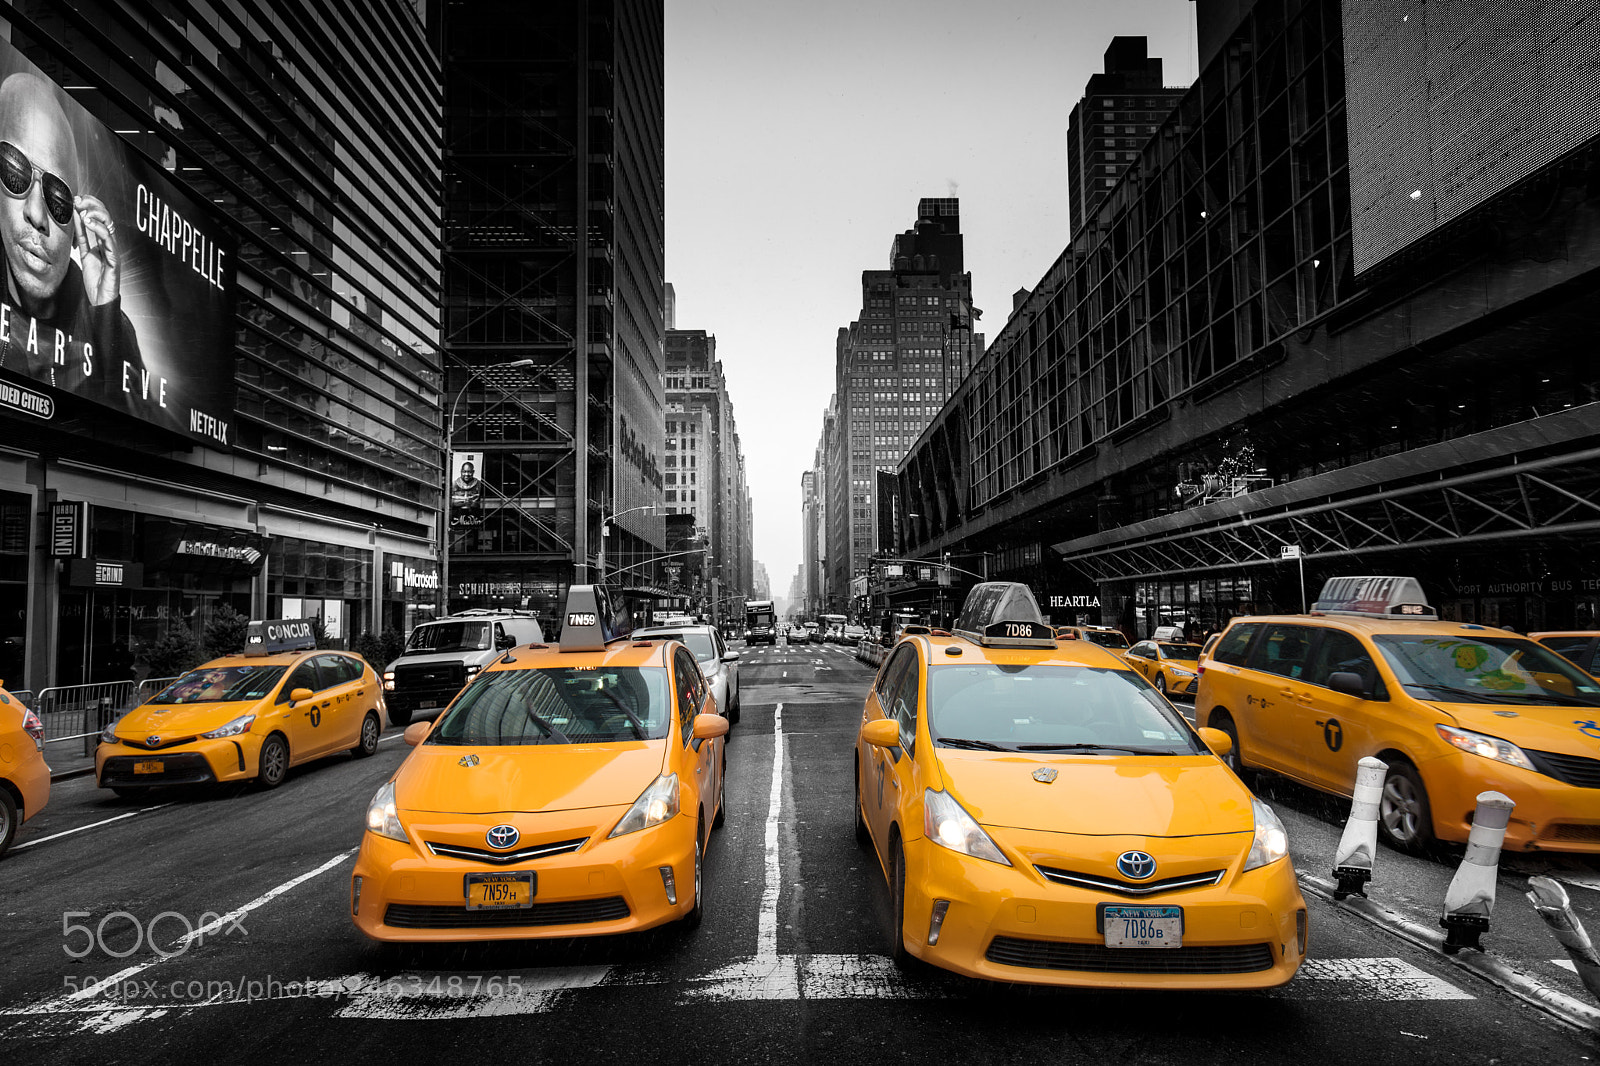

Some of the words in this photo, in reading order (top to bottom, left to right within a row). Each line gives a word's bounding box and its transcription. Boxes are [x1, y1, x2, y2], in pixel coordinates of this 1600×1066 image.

[136, 184, 225, 291] CHAPPELLE
[123, 360, 167, 408] EVE
[21, 392, 50, 415] CITIES
[190, 408, 228, 445] NETFLIX
[55, 516, 74, 555] GRIND
[102, 567, 123, 582] GRIND
[404, 567, 438, 589] Microsoft
[1458, 584, 1481, 595] PORT
[1488, 581, 1543, 593] AUTHORITY
[1551, 580, 1573, 591] BUS
[569, 614, 595, 625] 7N59
[267, 622, 311, 641] CONCUR
[1005, 623, 1032, 637] 7D86
[482, 884, 517, 901] 7N59H
[1123, 910, 1140, 918] NEW
[1142, 910, 1162, 918] YORK
[1123, 919, 1164, 939] 7D86B
